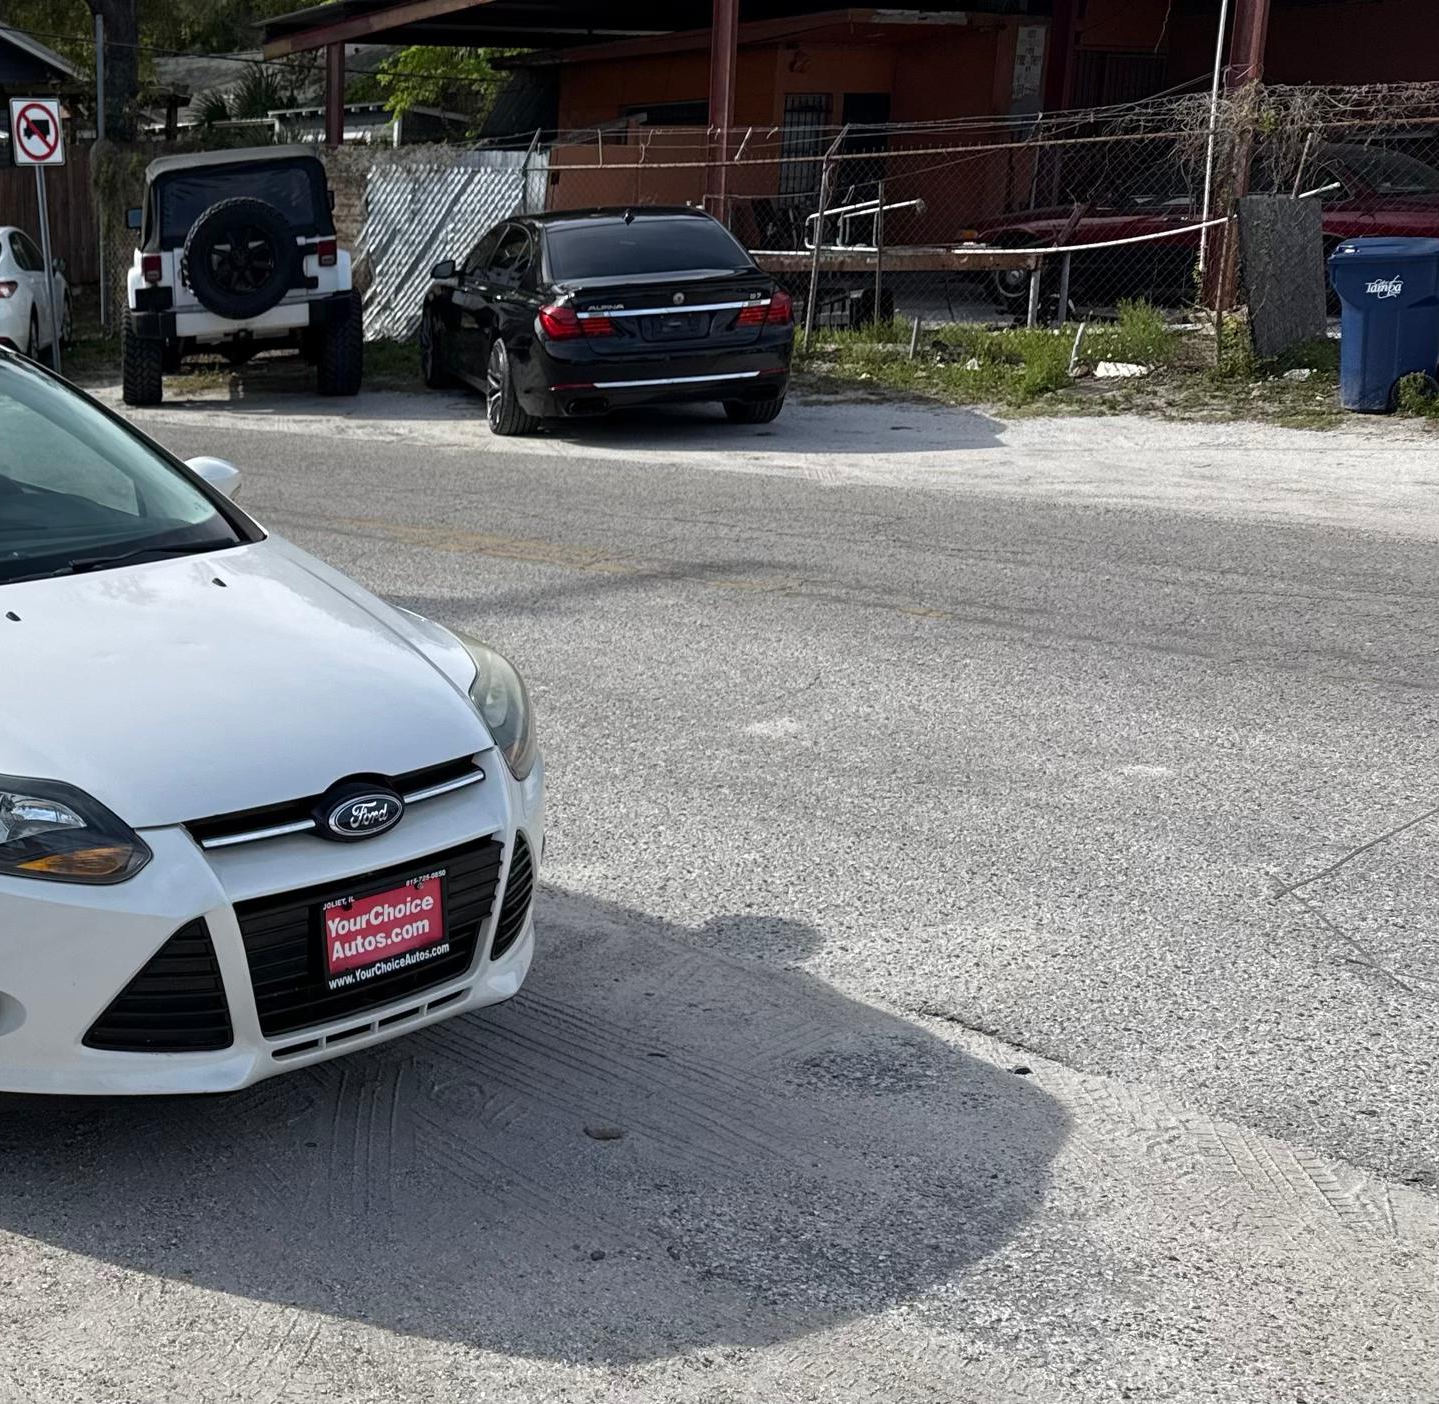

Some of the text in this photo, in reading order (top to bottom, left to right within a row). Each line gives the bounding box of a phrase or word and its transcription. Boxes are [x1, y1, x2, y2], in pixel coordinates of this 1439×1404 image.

[1365, 275, 1403, 299] Tampa
[588, 303, 625, 312] ALPINA
[350, 801, 388, 828] Ford
[328, 895, 434, 937] YourChoice
[332, 919, 429, 962] Autos.com
[329, 943, 450, 990] www.YourChoiceAutos.com
